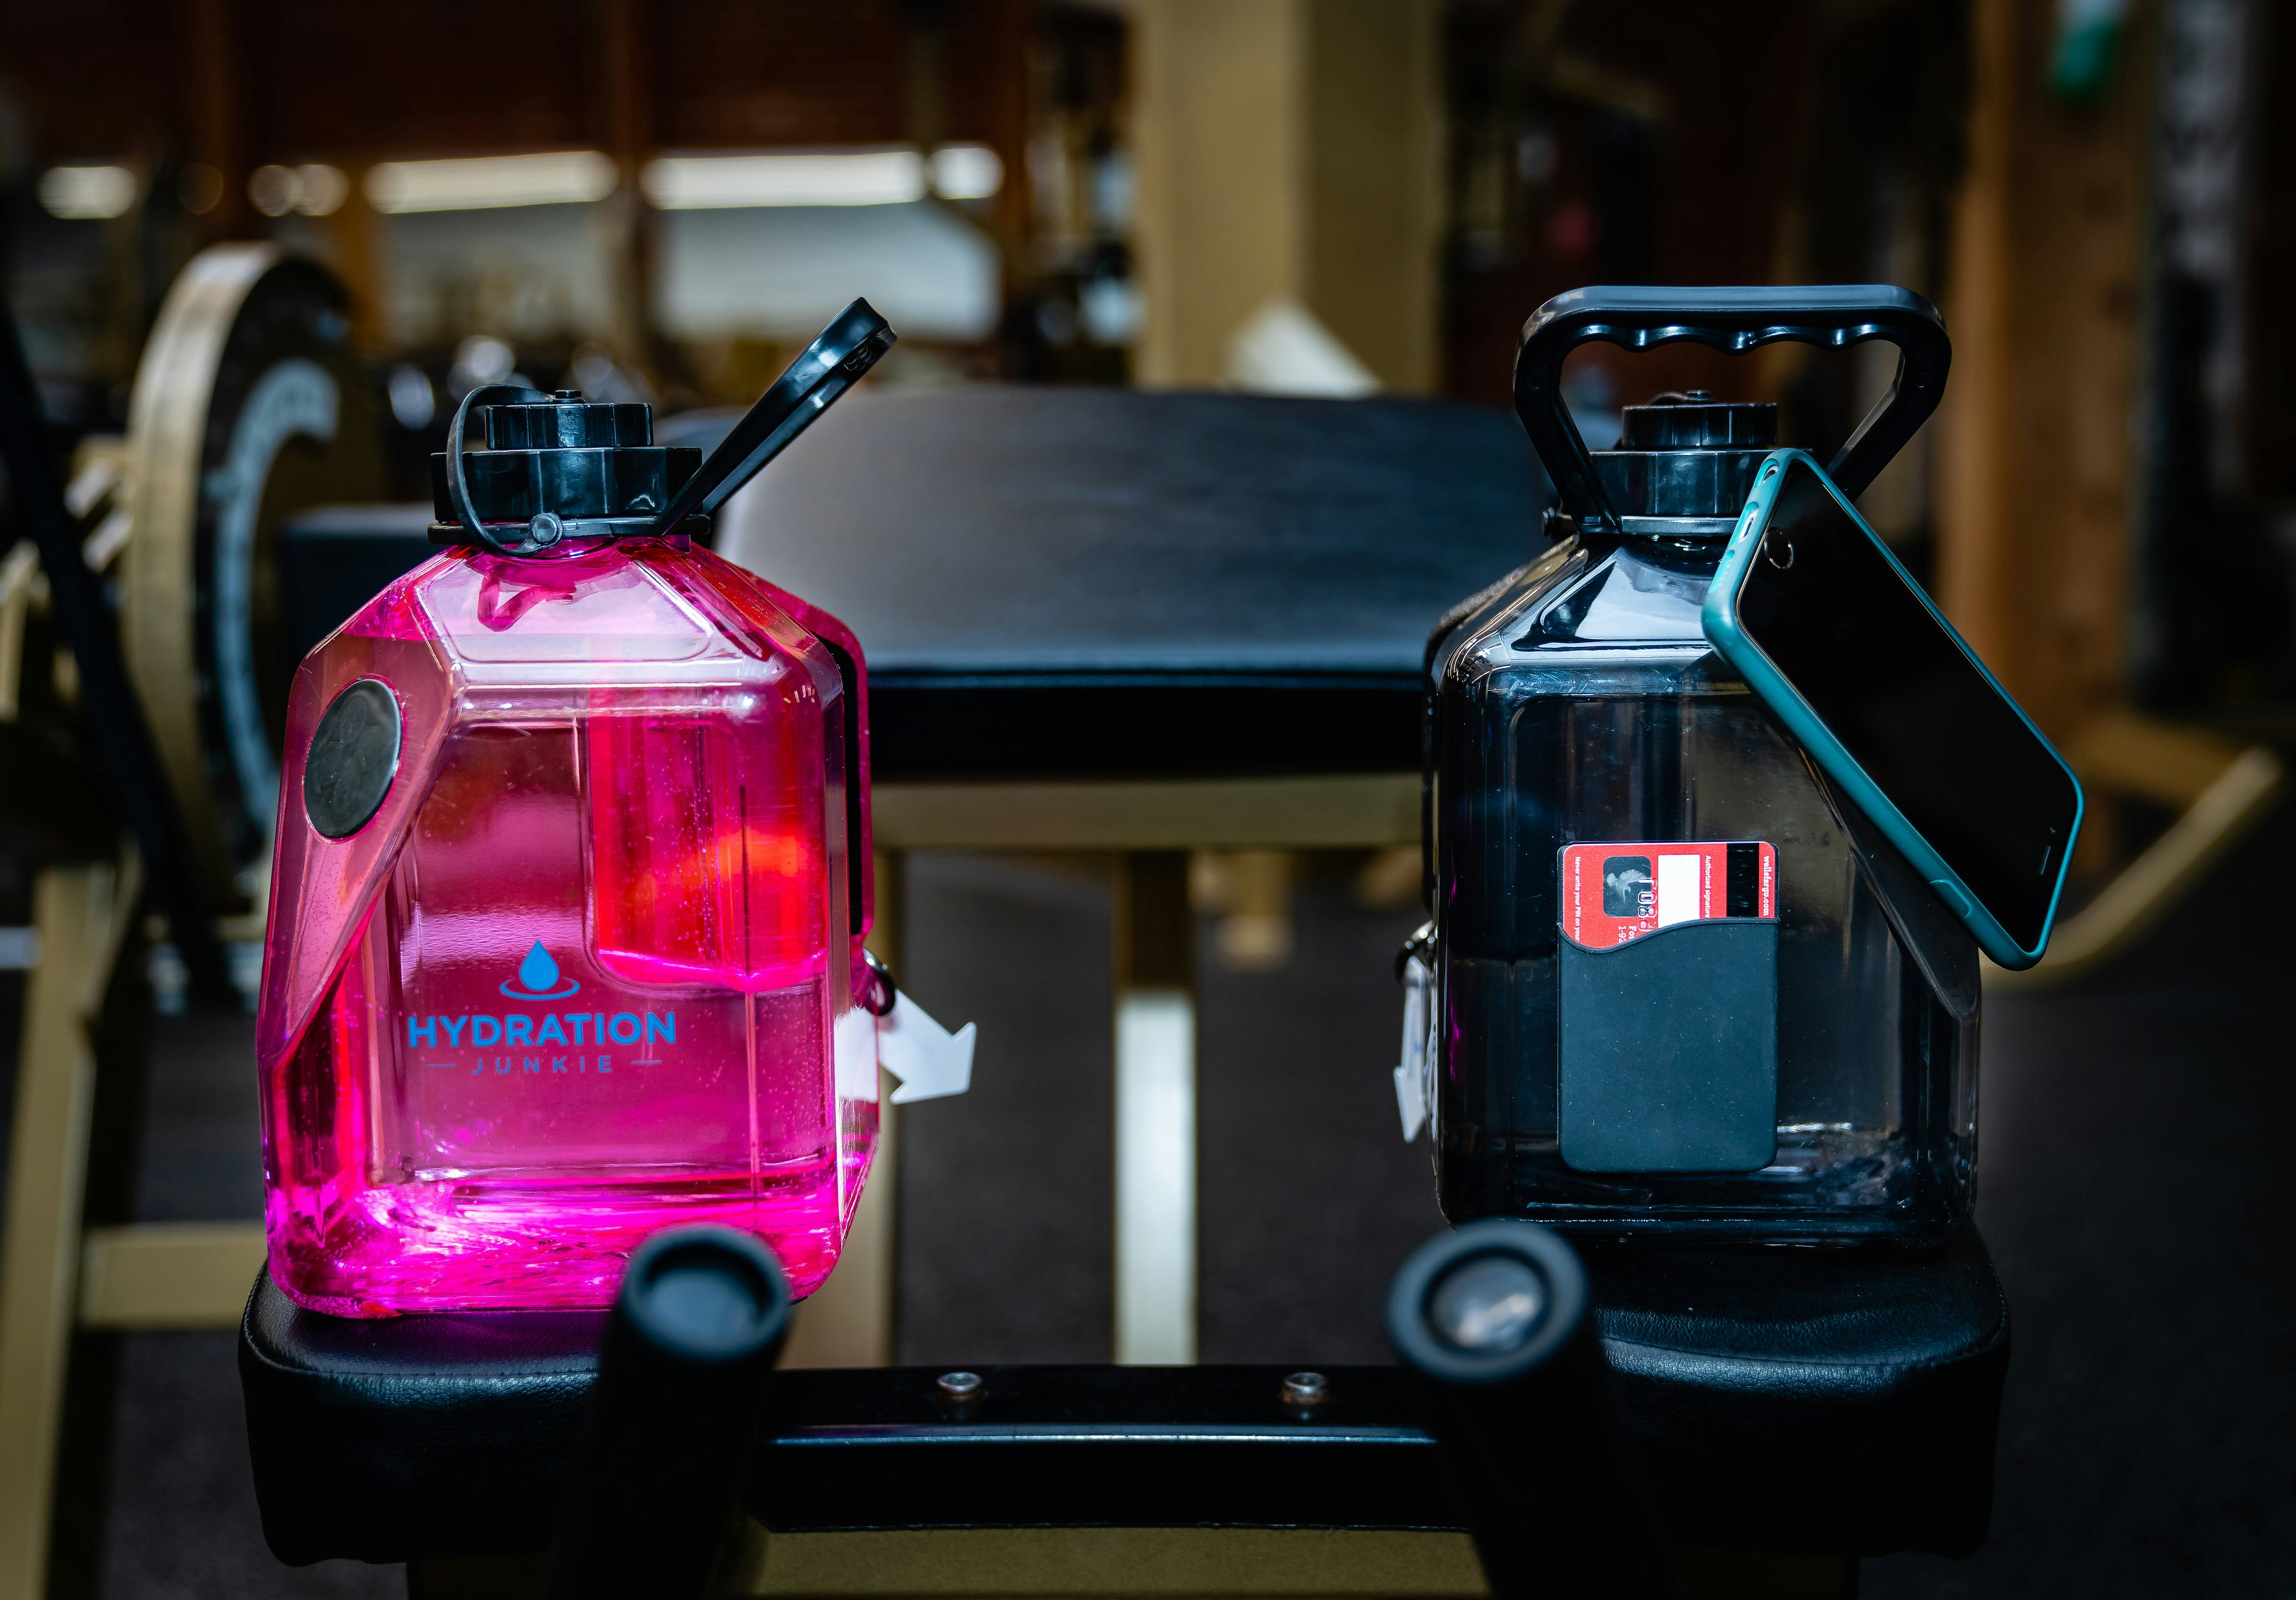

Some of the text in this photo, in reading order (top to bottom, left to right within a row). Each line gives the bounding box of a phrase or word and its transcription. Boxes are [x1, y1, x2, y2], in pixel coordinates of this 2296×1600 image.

[1762, 856, 1772, 916] wellsfargo.com
[1575, 917, 1580, 926] on
[408, 1012, 676, 1048] HYDRATION
[472, 1055, 613, 1075] JUNKIE
